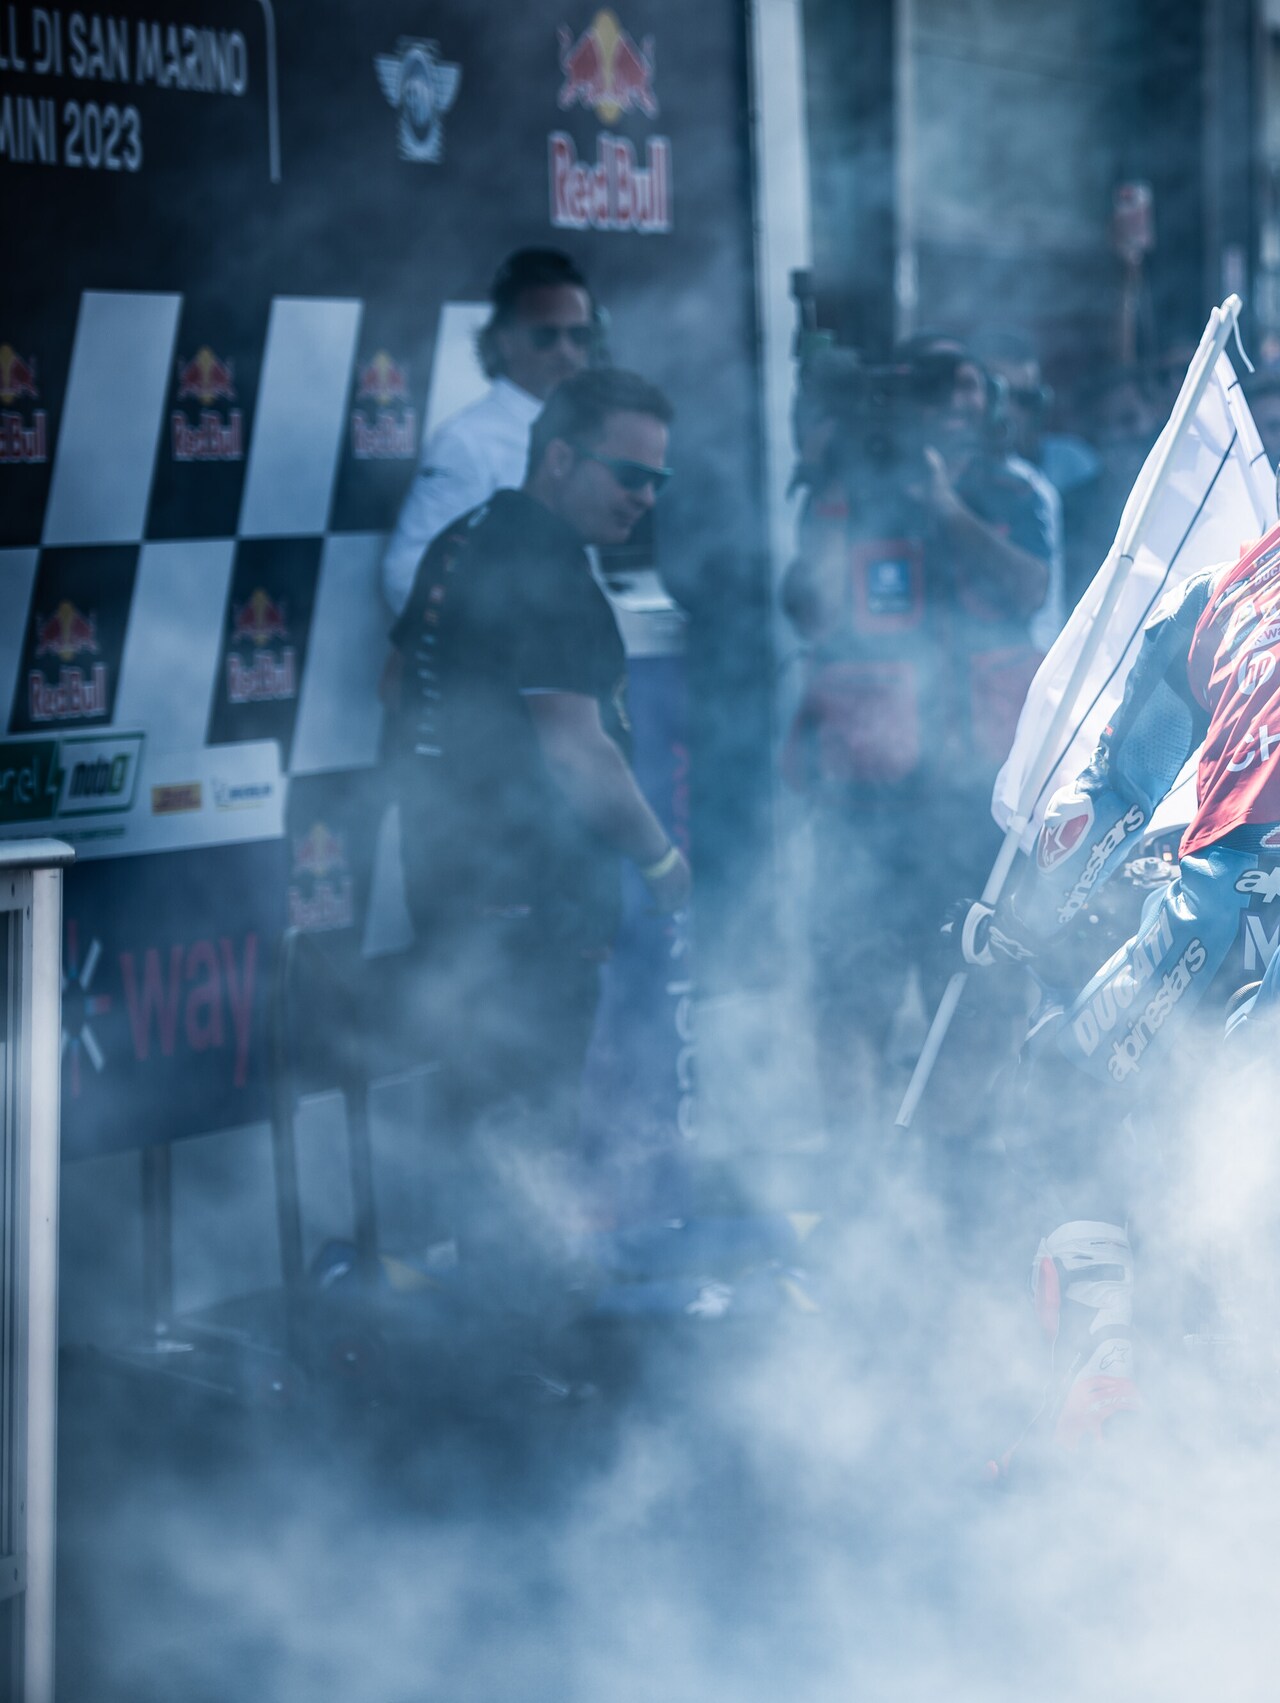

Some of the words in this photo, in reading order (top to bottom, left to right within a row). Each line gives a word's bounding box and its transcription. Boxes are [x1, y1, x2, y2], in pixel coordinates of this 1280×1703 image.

[0, 3, 26, 73] L
[32, 8, 62, 76] DI
[68, 12, 129, 84] SAN
[135, 20, 248, 97] MARINO
[64, 100, 143, 173] 2023
[118, 931, 260, 1091] way
[1073, 907, 1175, 1057] DUCATI
[1107, 938, 1207, 1083] alpinestars
